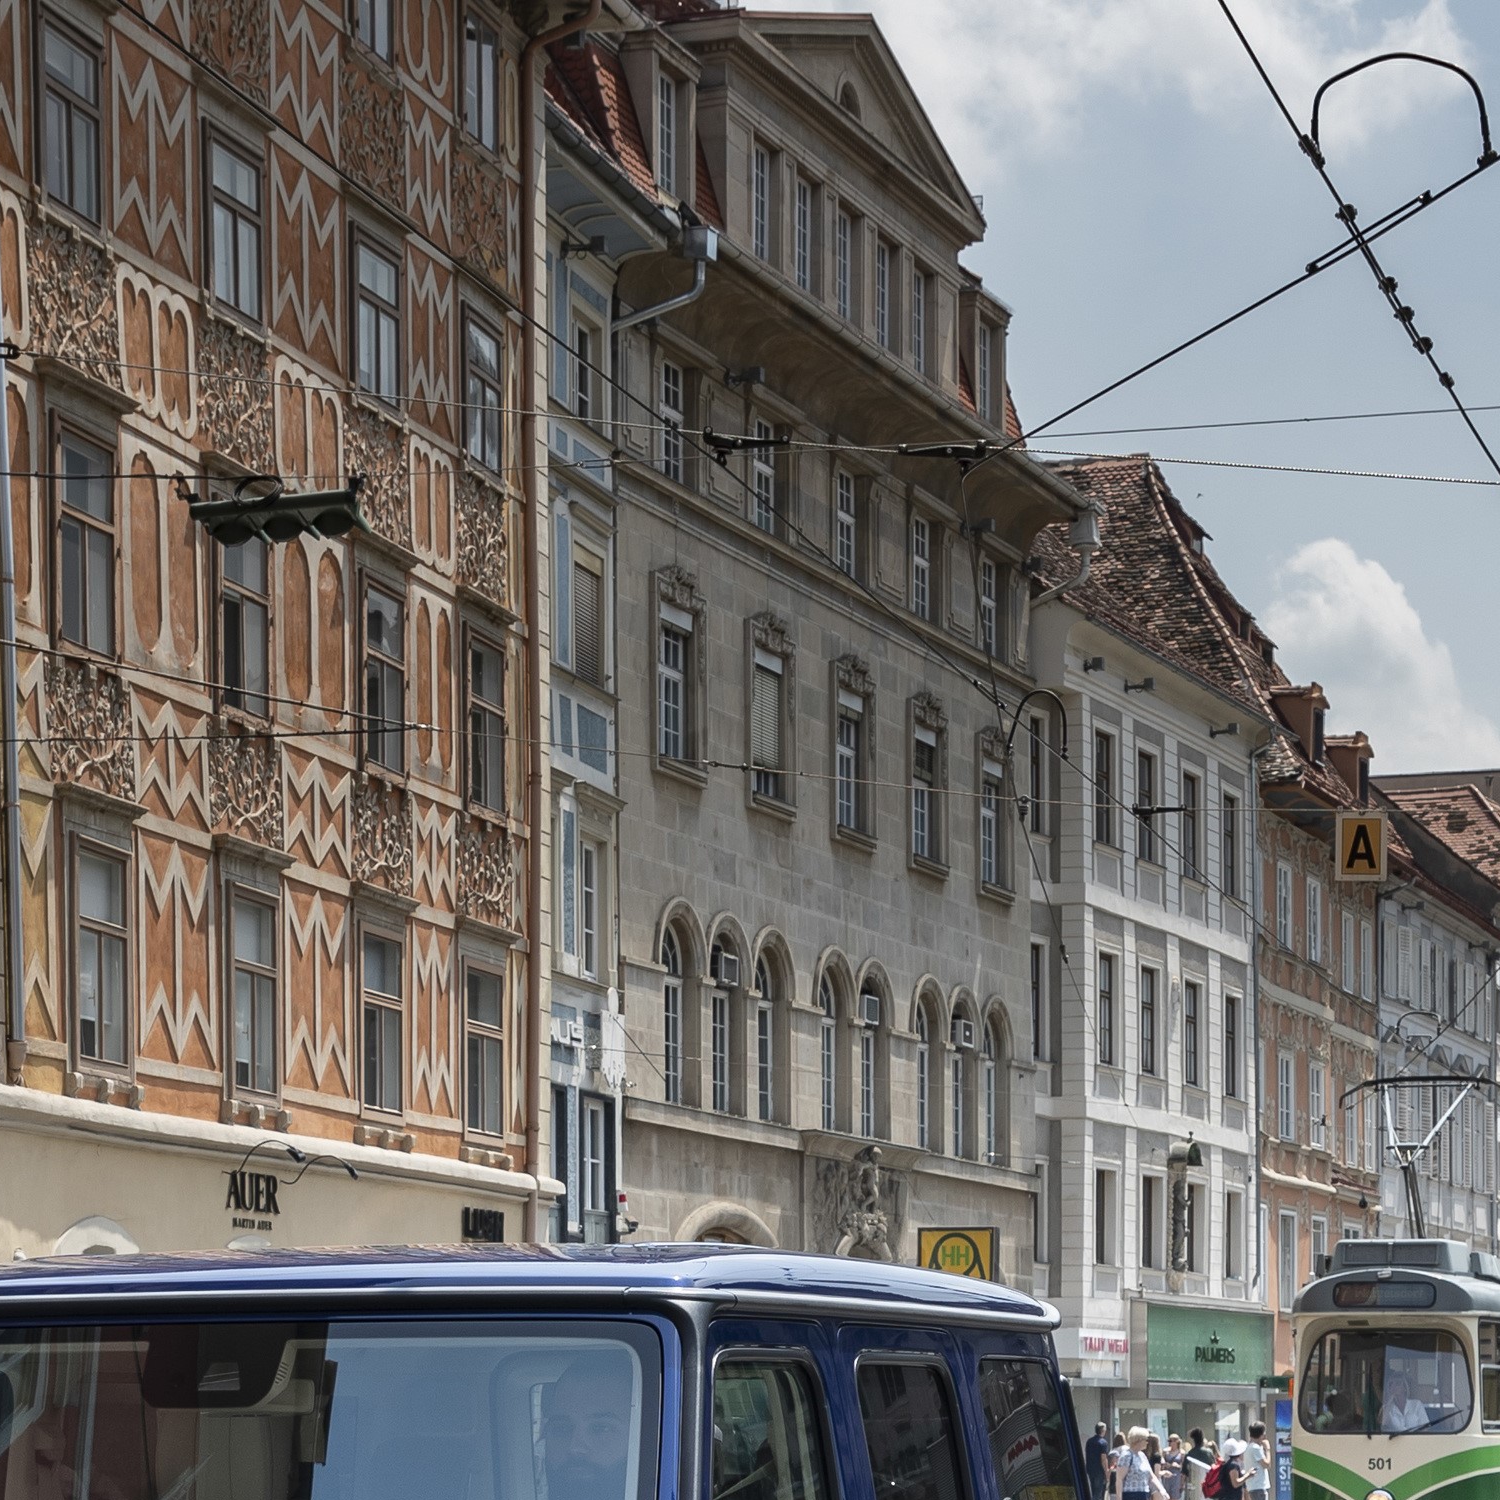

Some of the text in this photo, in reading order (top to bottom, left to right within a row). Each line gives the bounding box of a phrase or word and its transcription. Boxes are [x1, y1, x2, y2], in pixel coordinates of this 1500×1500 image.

[1346, 824, 1376, 869] A
[225, 1170, 281, 1214] AUER
[232, 1217, 273, 1231] MARTIN AUER
[941, 1246, 970, 1267] HH
[1194, 1346, 1235, 1364] PALMERS
[1368, 1458, 1393, 1470] 501
